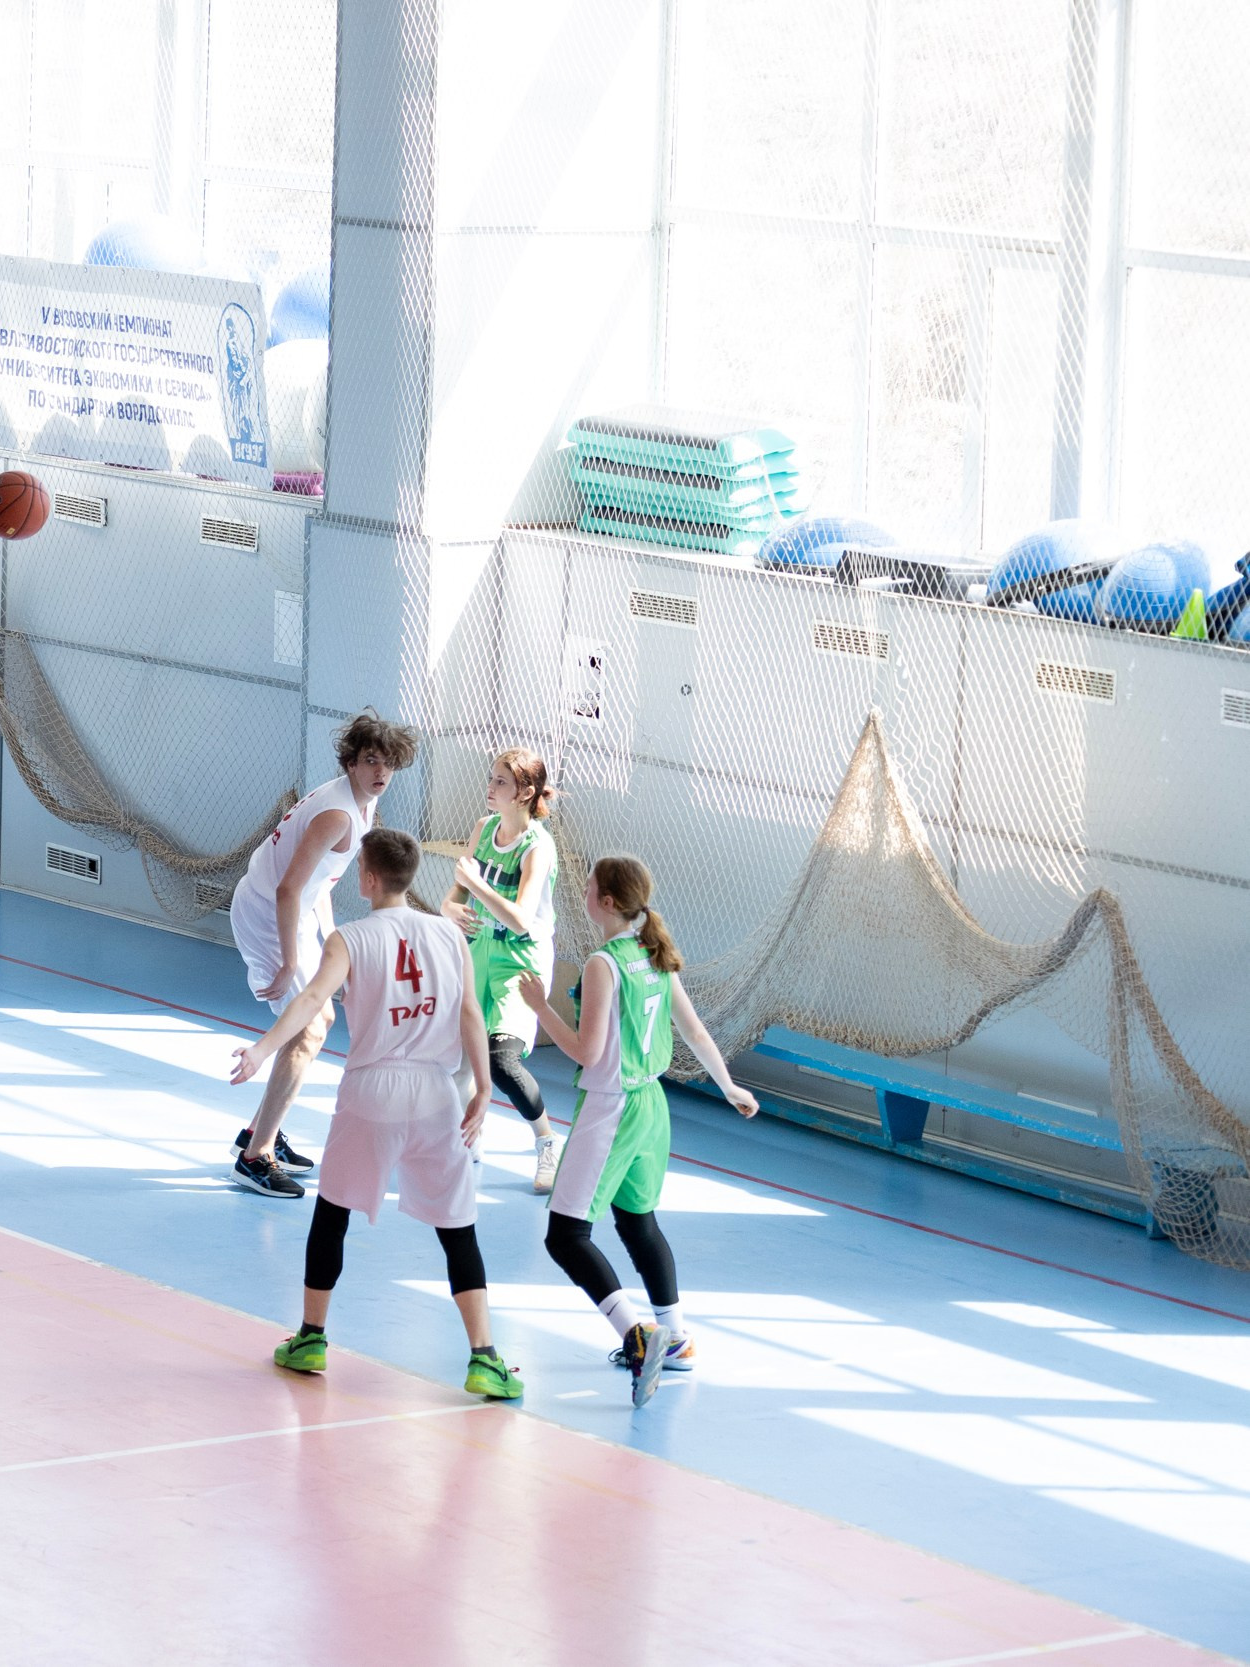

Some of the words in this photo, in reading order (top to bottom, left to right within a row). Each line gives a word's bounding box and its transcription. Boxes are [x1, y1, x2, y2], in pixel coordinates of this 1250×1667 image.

[28, 388, 46, 409] ПО
[483, 858, 504, 886] 11
[395, 938, 424, 994] 4
[642, 992, 662, 1057] 7
